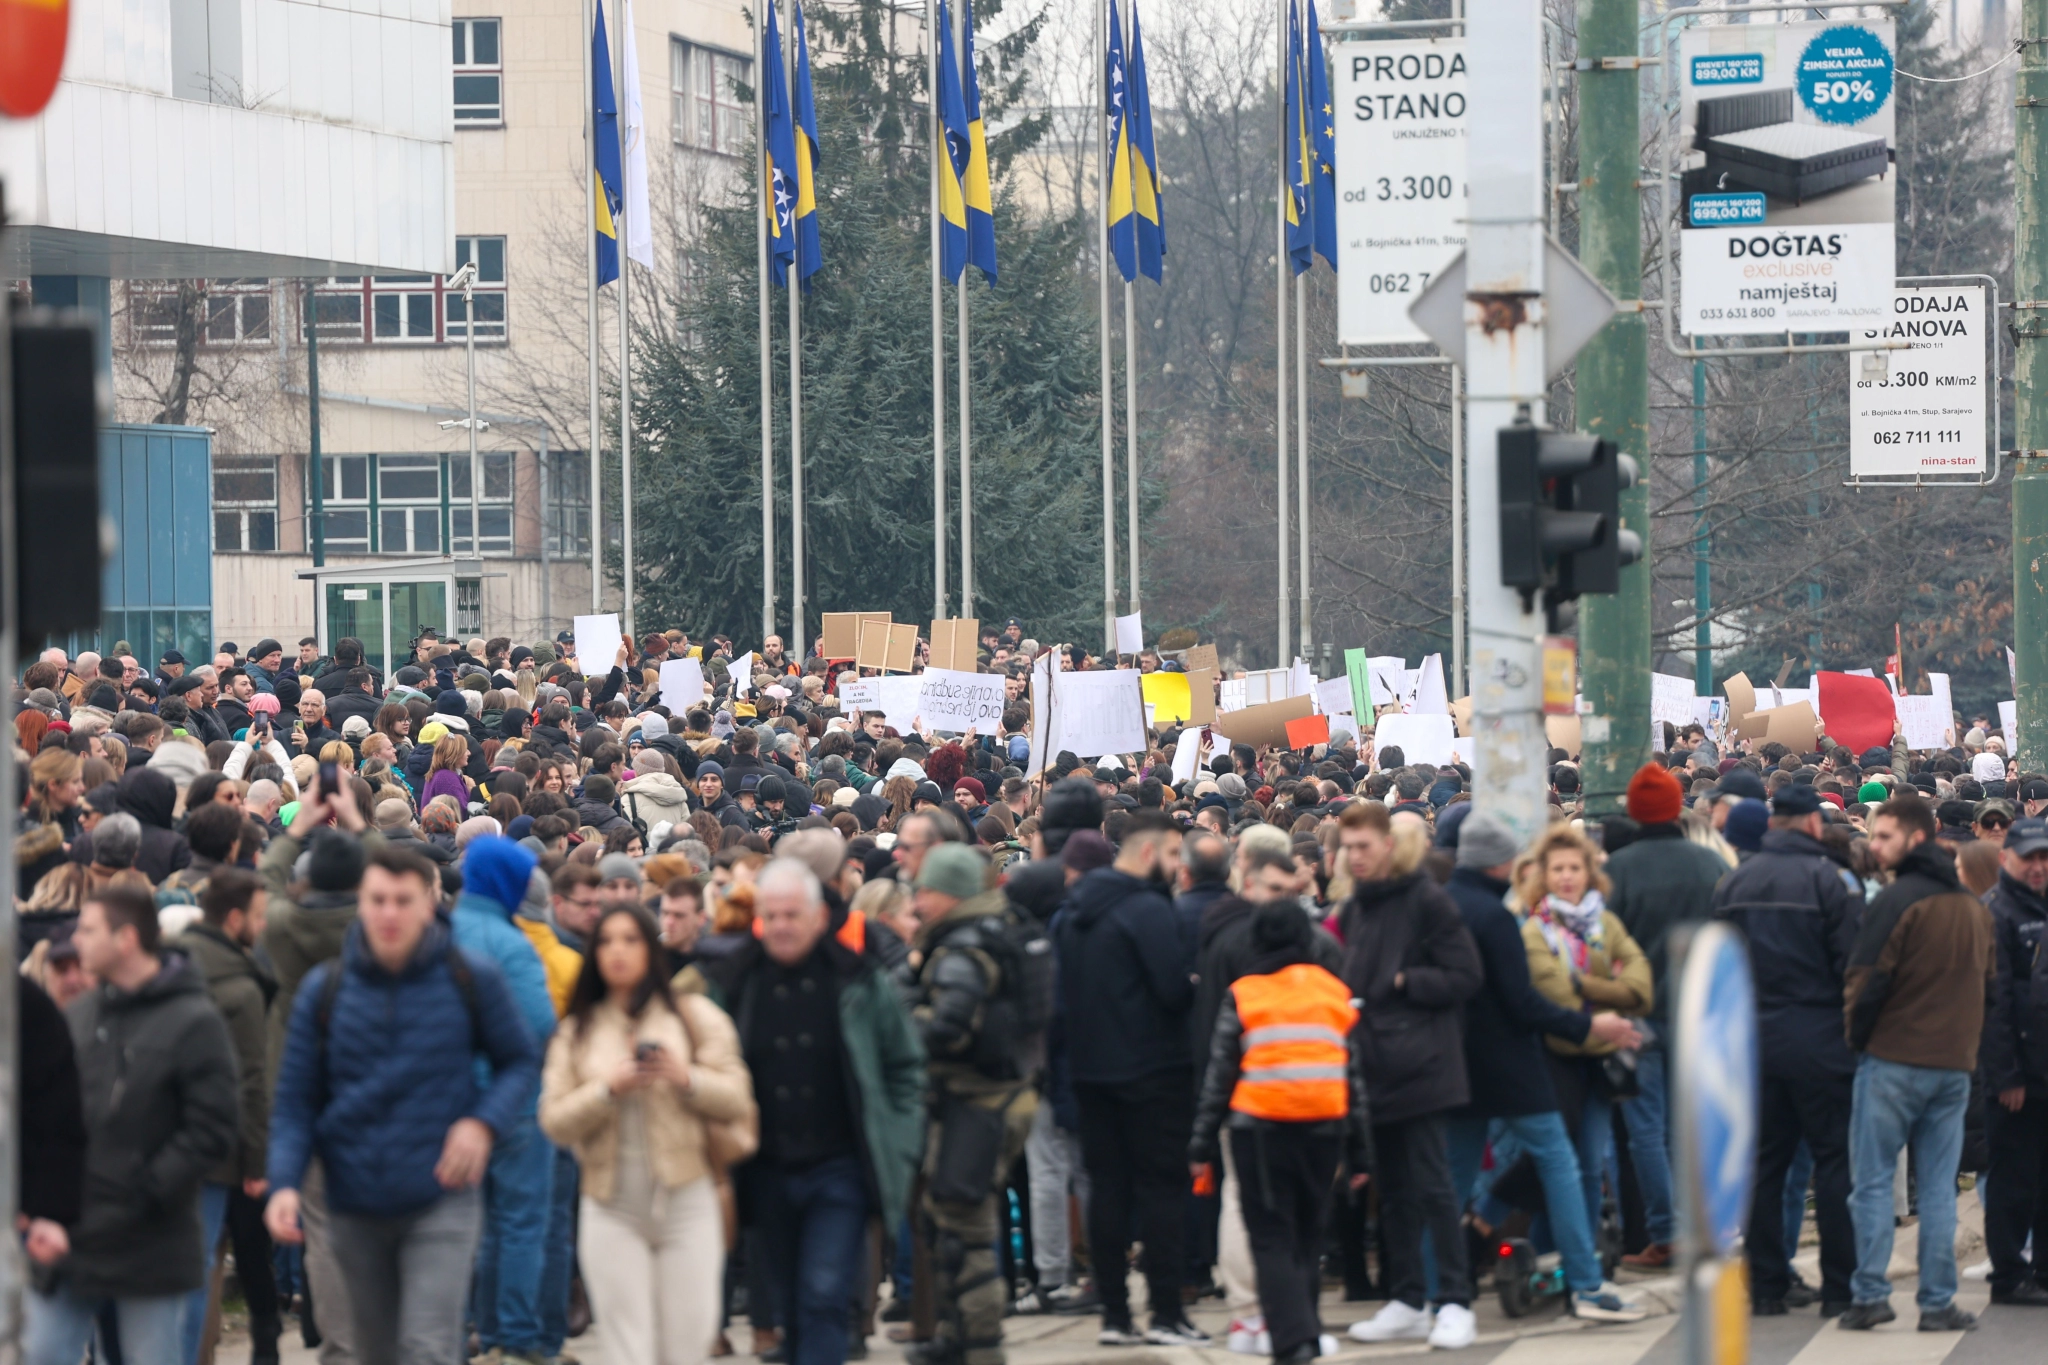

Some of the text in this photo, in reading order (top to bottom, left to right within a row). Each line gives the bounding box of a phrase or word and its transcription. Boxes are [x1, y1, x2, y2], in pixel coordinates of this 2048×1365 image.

[1824, 47, 1864, 57] VELIKA
[1352, 53, 1466, 81] PRODA
[1695, 60, 1726, 69] KREVET
[1803, 58, 1885, 70] ZIMSKA AKCIJA
[1695, 67, 1759, 81] 899,00 KM
[1813, 80, 1876, 104] 50%
[1355, 92, 1466, 121] STANO
[1393, 127, 1456, 139] UKNJIŽENO
[1344, 187, 1365, 202] od
[1377, 174, 1452, 201] 3.300
[1693, 200, 1728, 208] MADRAC
[1693, 206, 1762, 221] 699,00 KM
[1366, 236, 1411, 249] Bojnička
[1743, 260, 1832, 278] exclusive
[1370, 273, 1410, 293] 062
[1739, 281, 1837, 304] namještaj
[1894, 295, 1969, 314] ODAJA
[1700, 307, 1776, 320] 033 631 800
[1786, 308, 1831, 317] SARAJEVO
[1935, 376, 1977, 386] KM/m2
[1872, 409, 1902, 418] Bojnička
[1922, 408, 1940, 417] Stup,
[1942, 408, 1973, 416] Sarajevo
[1873, 430, 1961, 445] 062 711 111
[1921, 457, 1976, 466] nina-stan
[1653, 699, 1689, 723] RAMOTA
